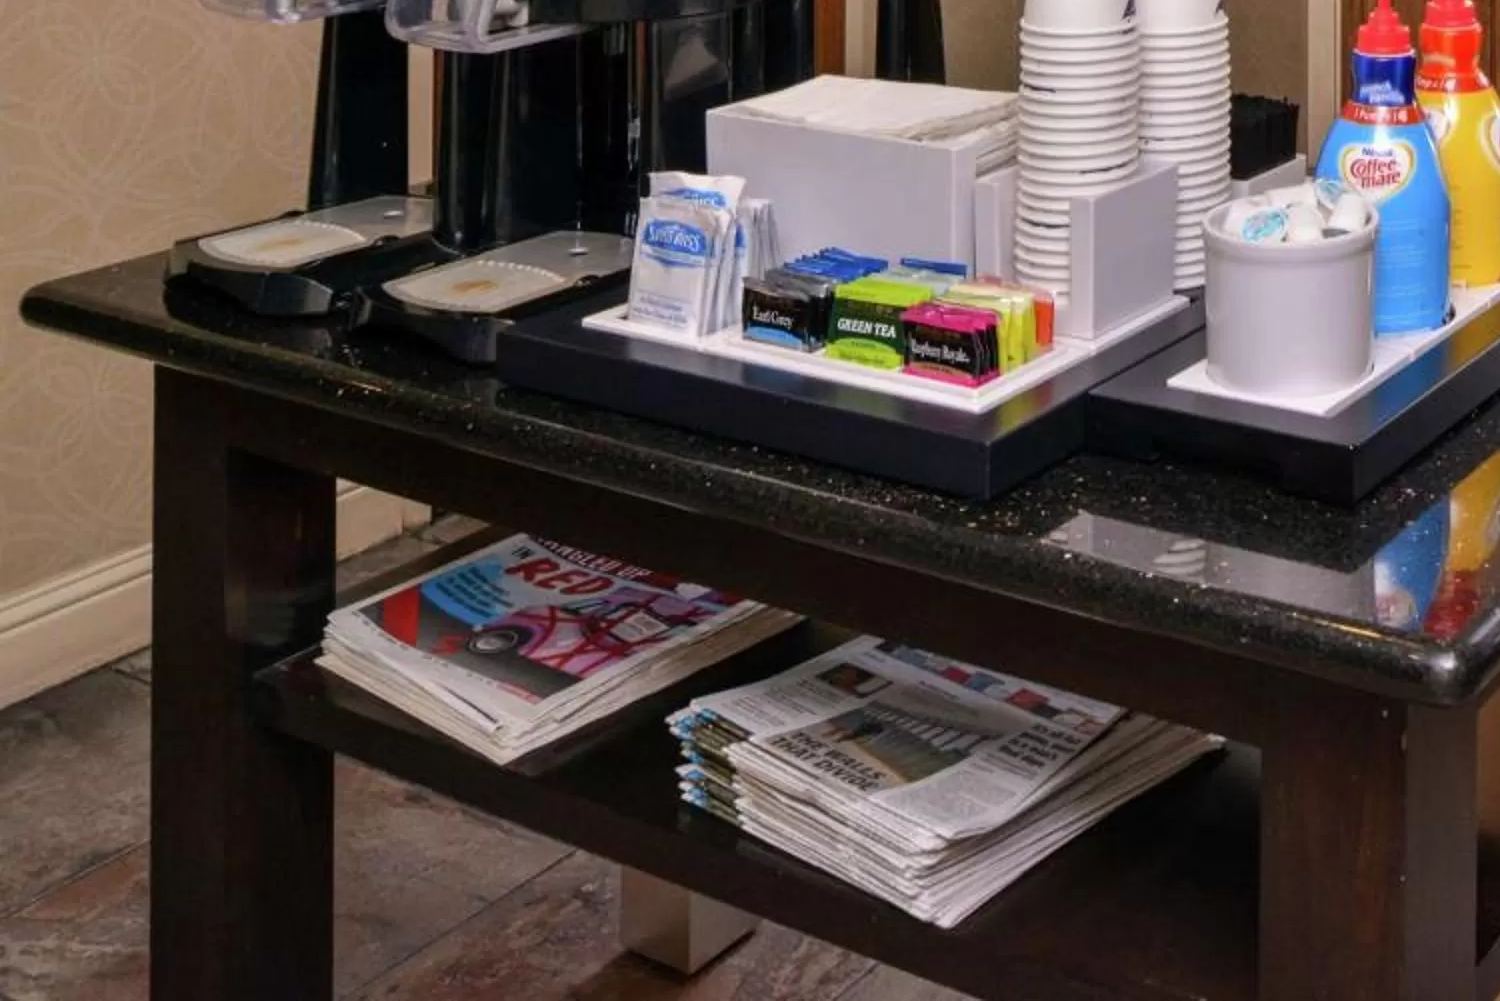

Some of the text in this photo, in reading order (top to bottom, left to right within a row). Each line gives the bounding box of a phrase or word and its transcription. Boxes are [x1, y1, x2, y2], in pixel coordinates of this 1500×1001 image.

[837, 318, 897, 339] GREEN TEA
[504, 557, 615, 595] RED
[770, 737, 818, 761] THAT
